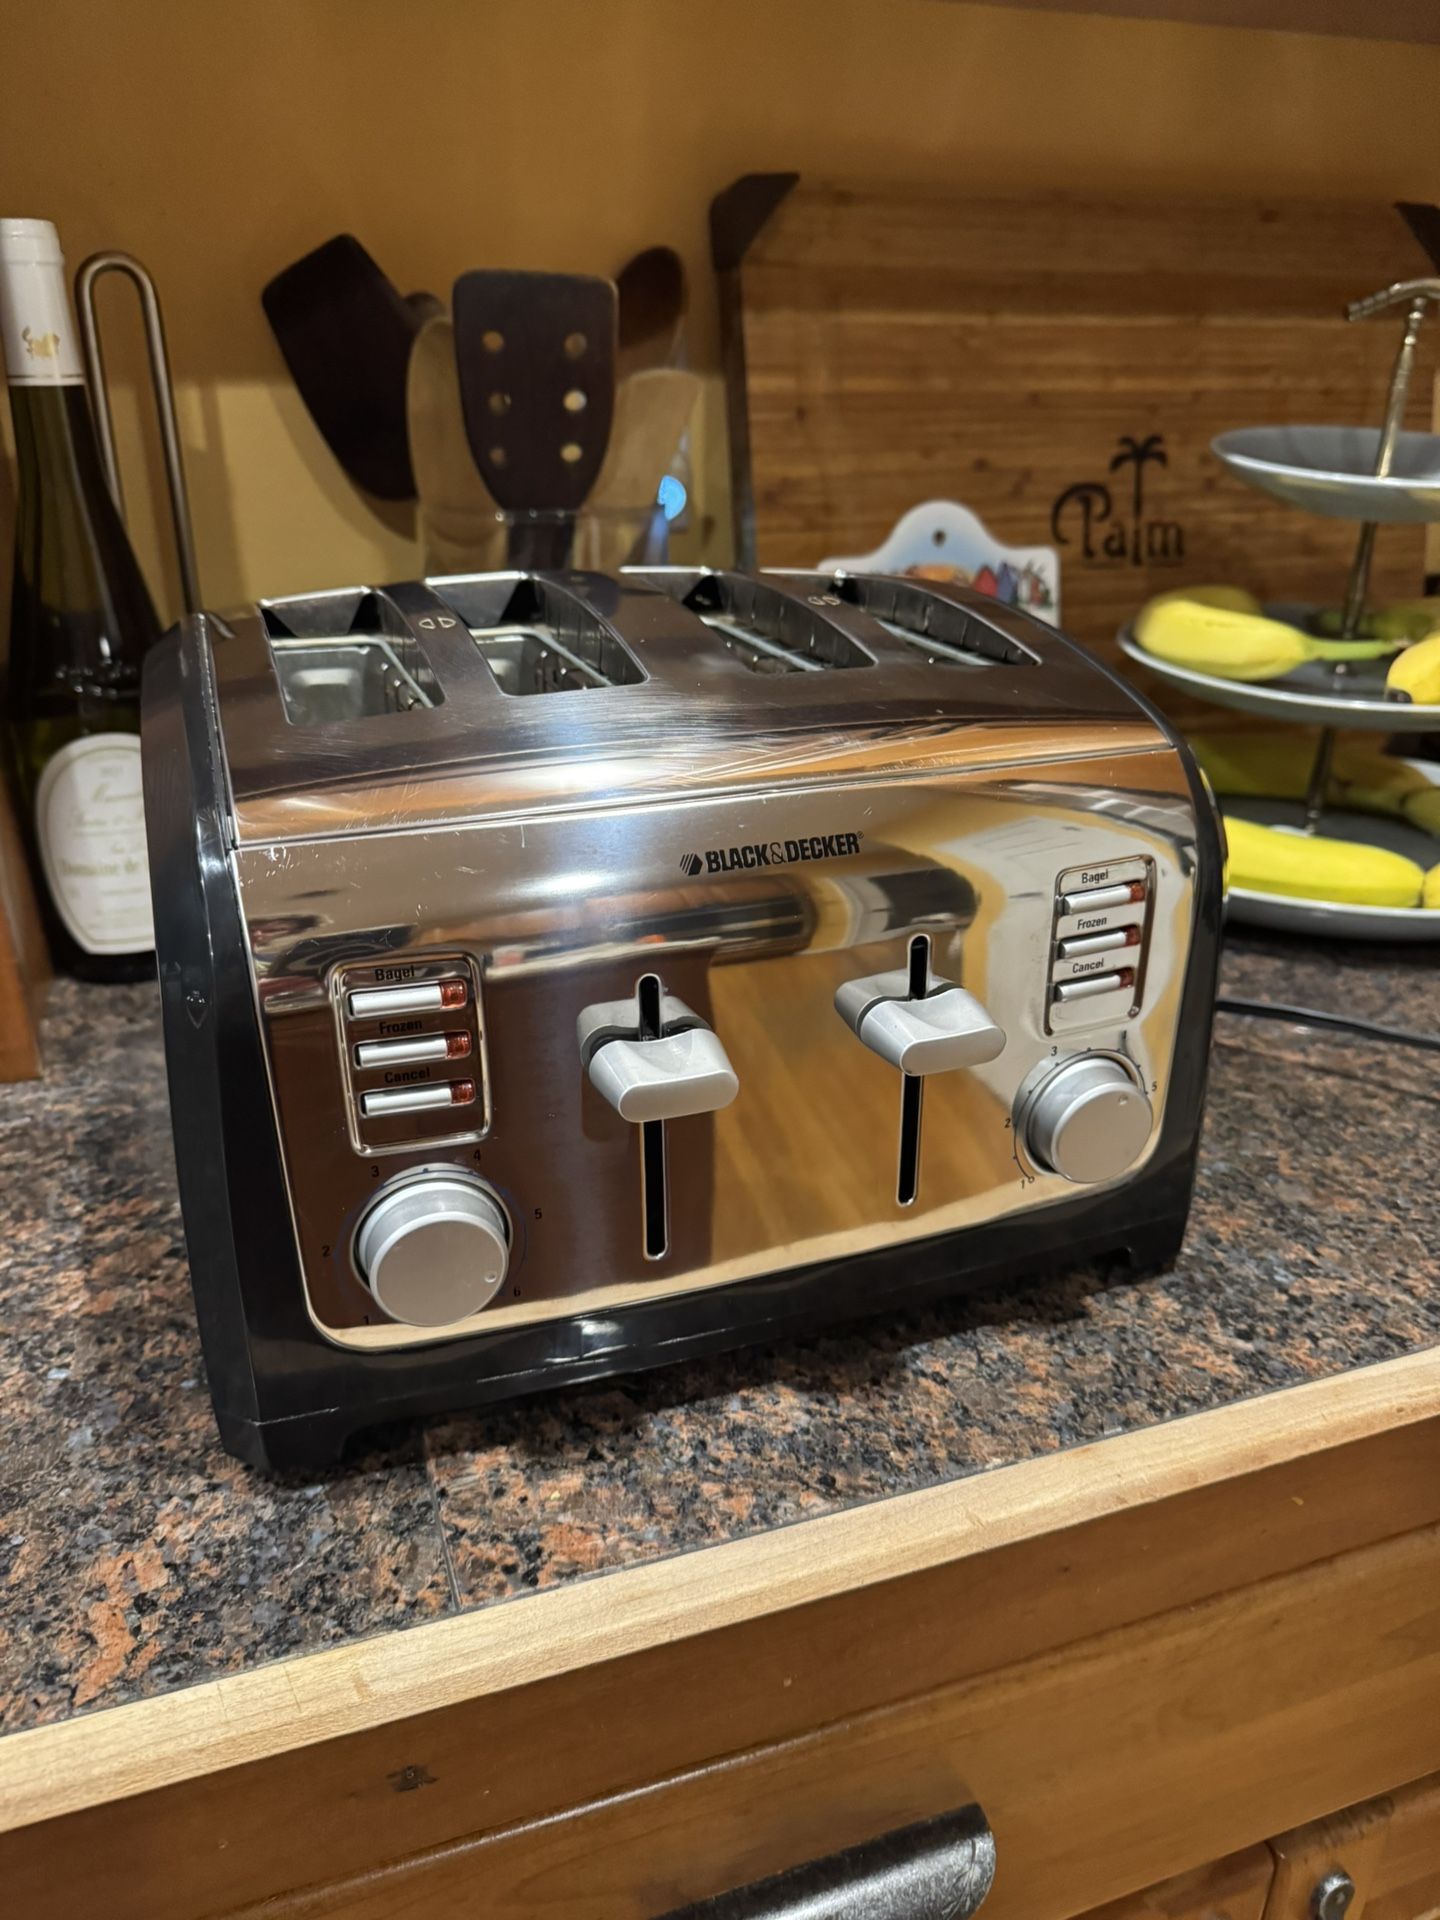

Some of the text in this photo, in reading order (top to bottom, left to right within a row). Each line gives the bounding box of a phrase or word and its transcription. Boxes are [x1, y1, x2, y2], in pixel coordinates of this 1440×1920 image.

[1052, 434, 1184, 566] Palm
[1081, 869, 1109, 885] Bagel
[1076, 915, 1107, 930] Frozen
[1072, 958, 1104, 974] Cancel
[374, 966, 415, 982] Bagel
[379, 1018, 422, 1035] Frozen
[1050, 1045, 1058, 1057] 3
[384, 1066, 430, 1084] Cancel
[1151, 1080, 1158, 1092] 5
[1004, 1117, 1011, 1129] 2
[472, 1150, 481, 1162] 4
[371, 1165, 379, 1178] 3
[534, 1208, 542, 1220] 5
[321, 1245, 330, 1258] 2
